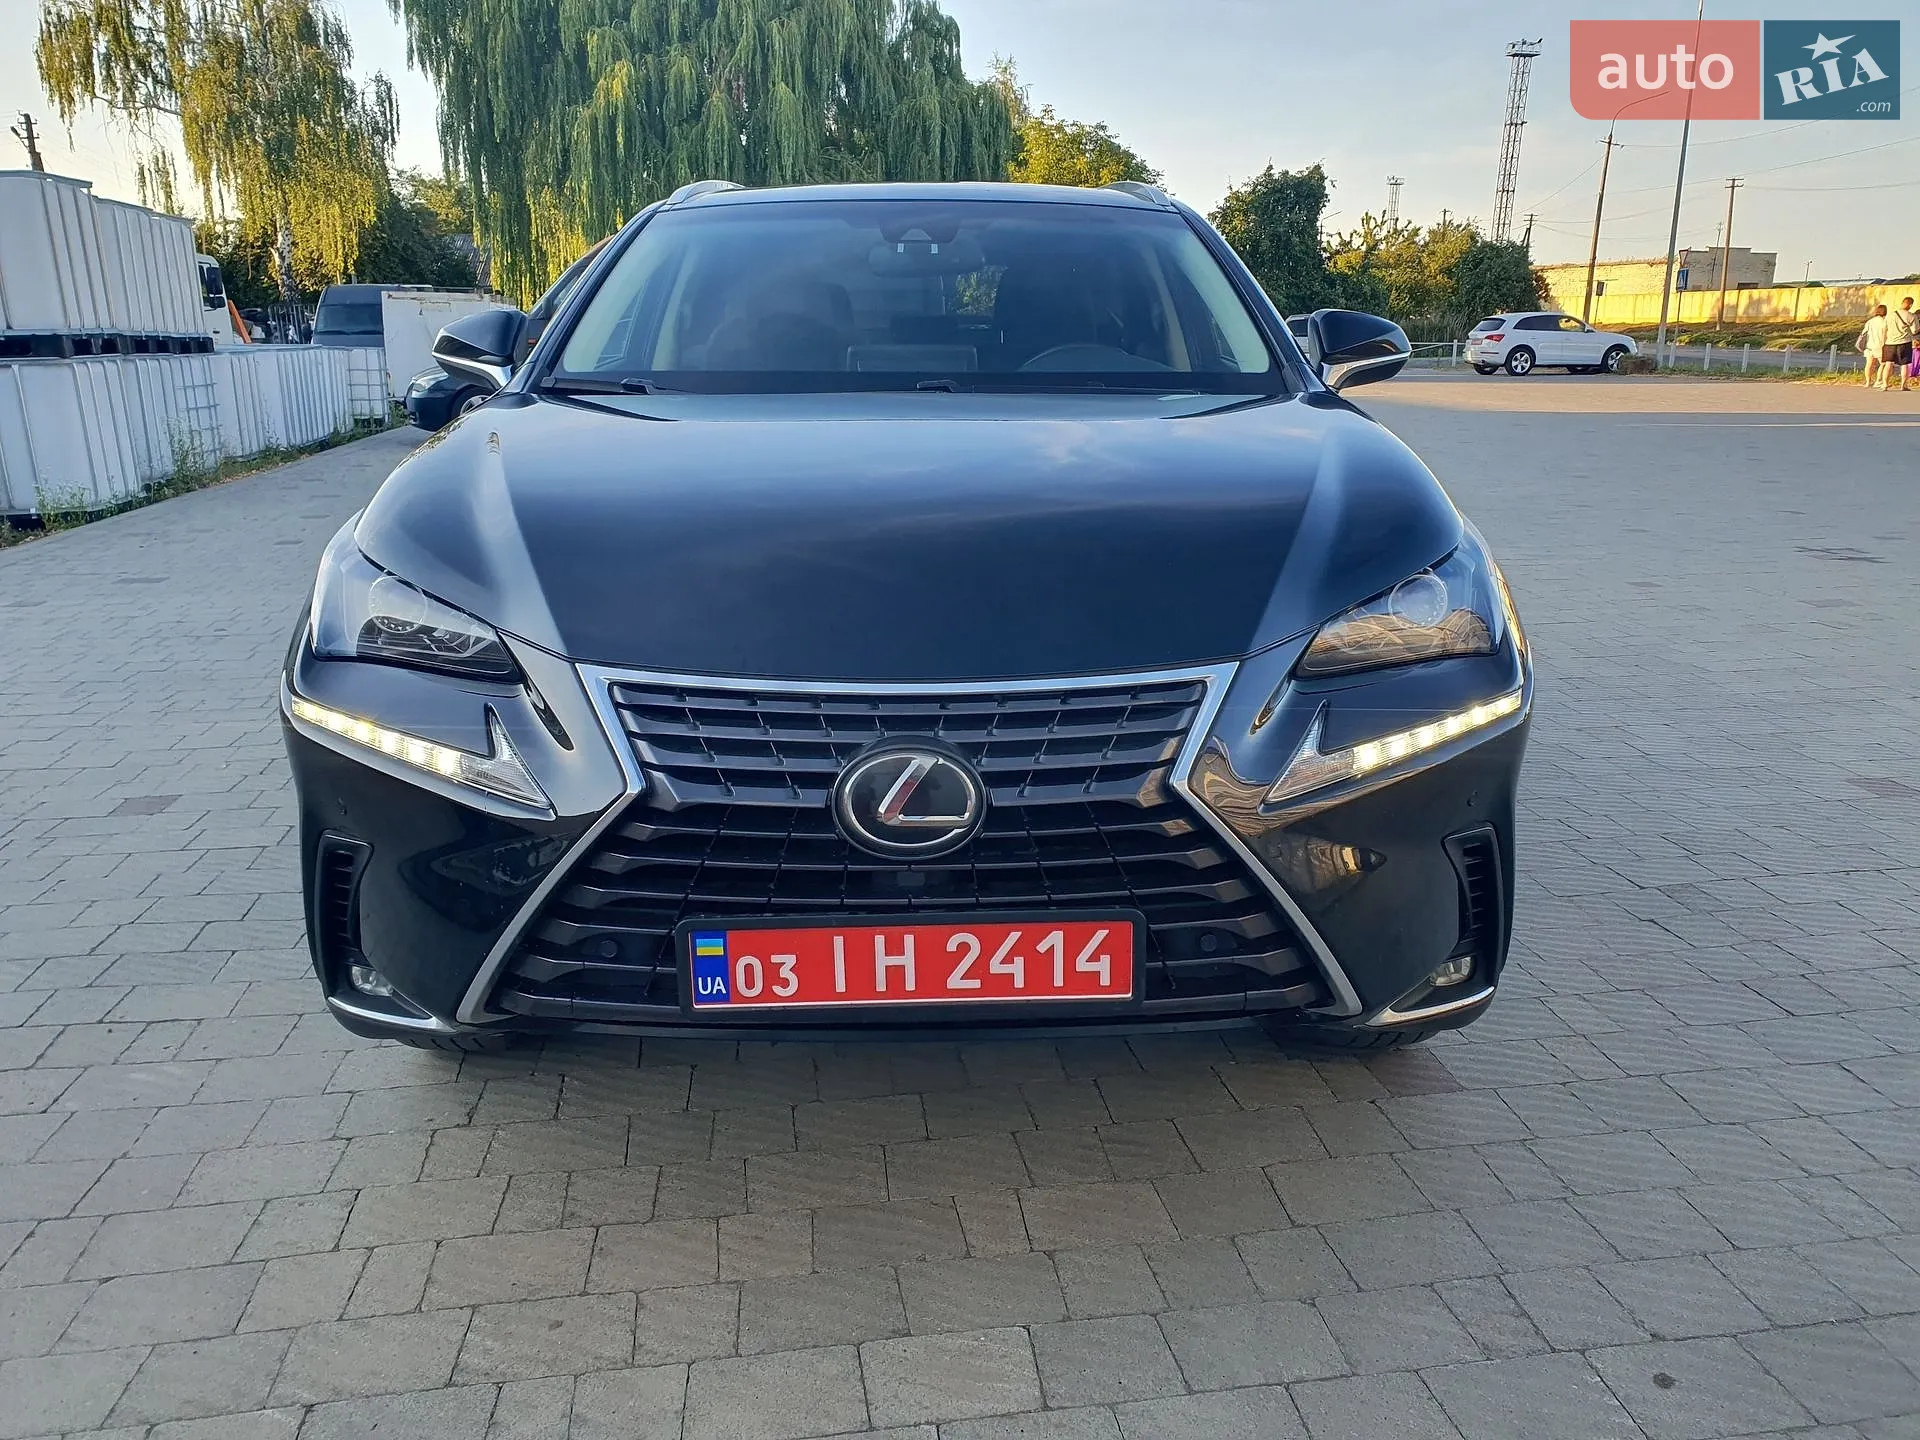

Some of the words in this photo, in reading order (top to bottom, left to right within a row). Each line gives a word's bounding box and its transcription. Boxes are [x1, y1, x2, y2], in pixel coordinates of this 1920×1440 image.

[698, 976, 727, 995] UA
[735, 954, 799, 998] 03
[946, 929, 1111, 989] 2414
